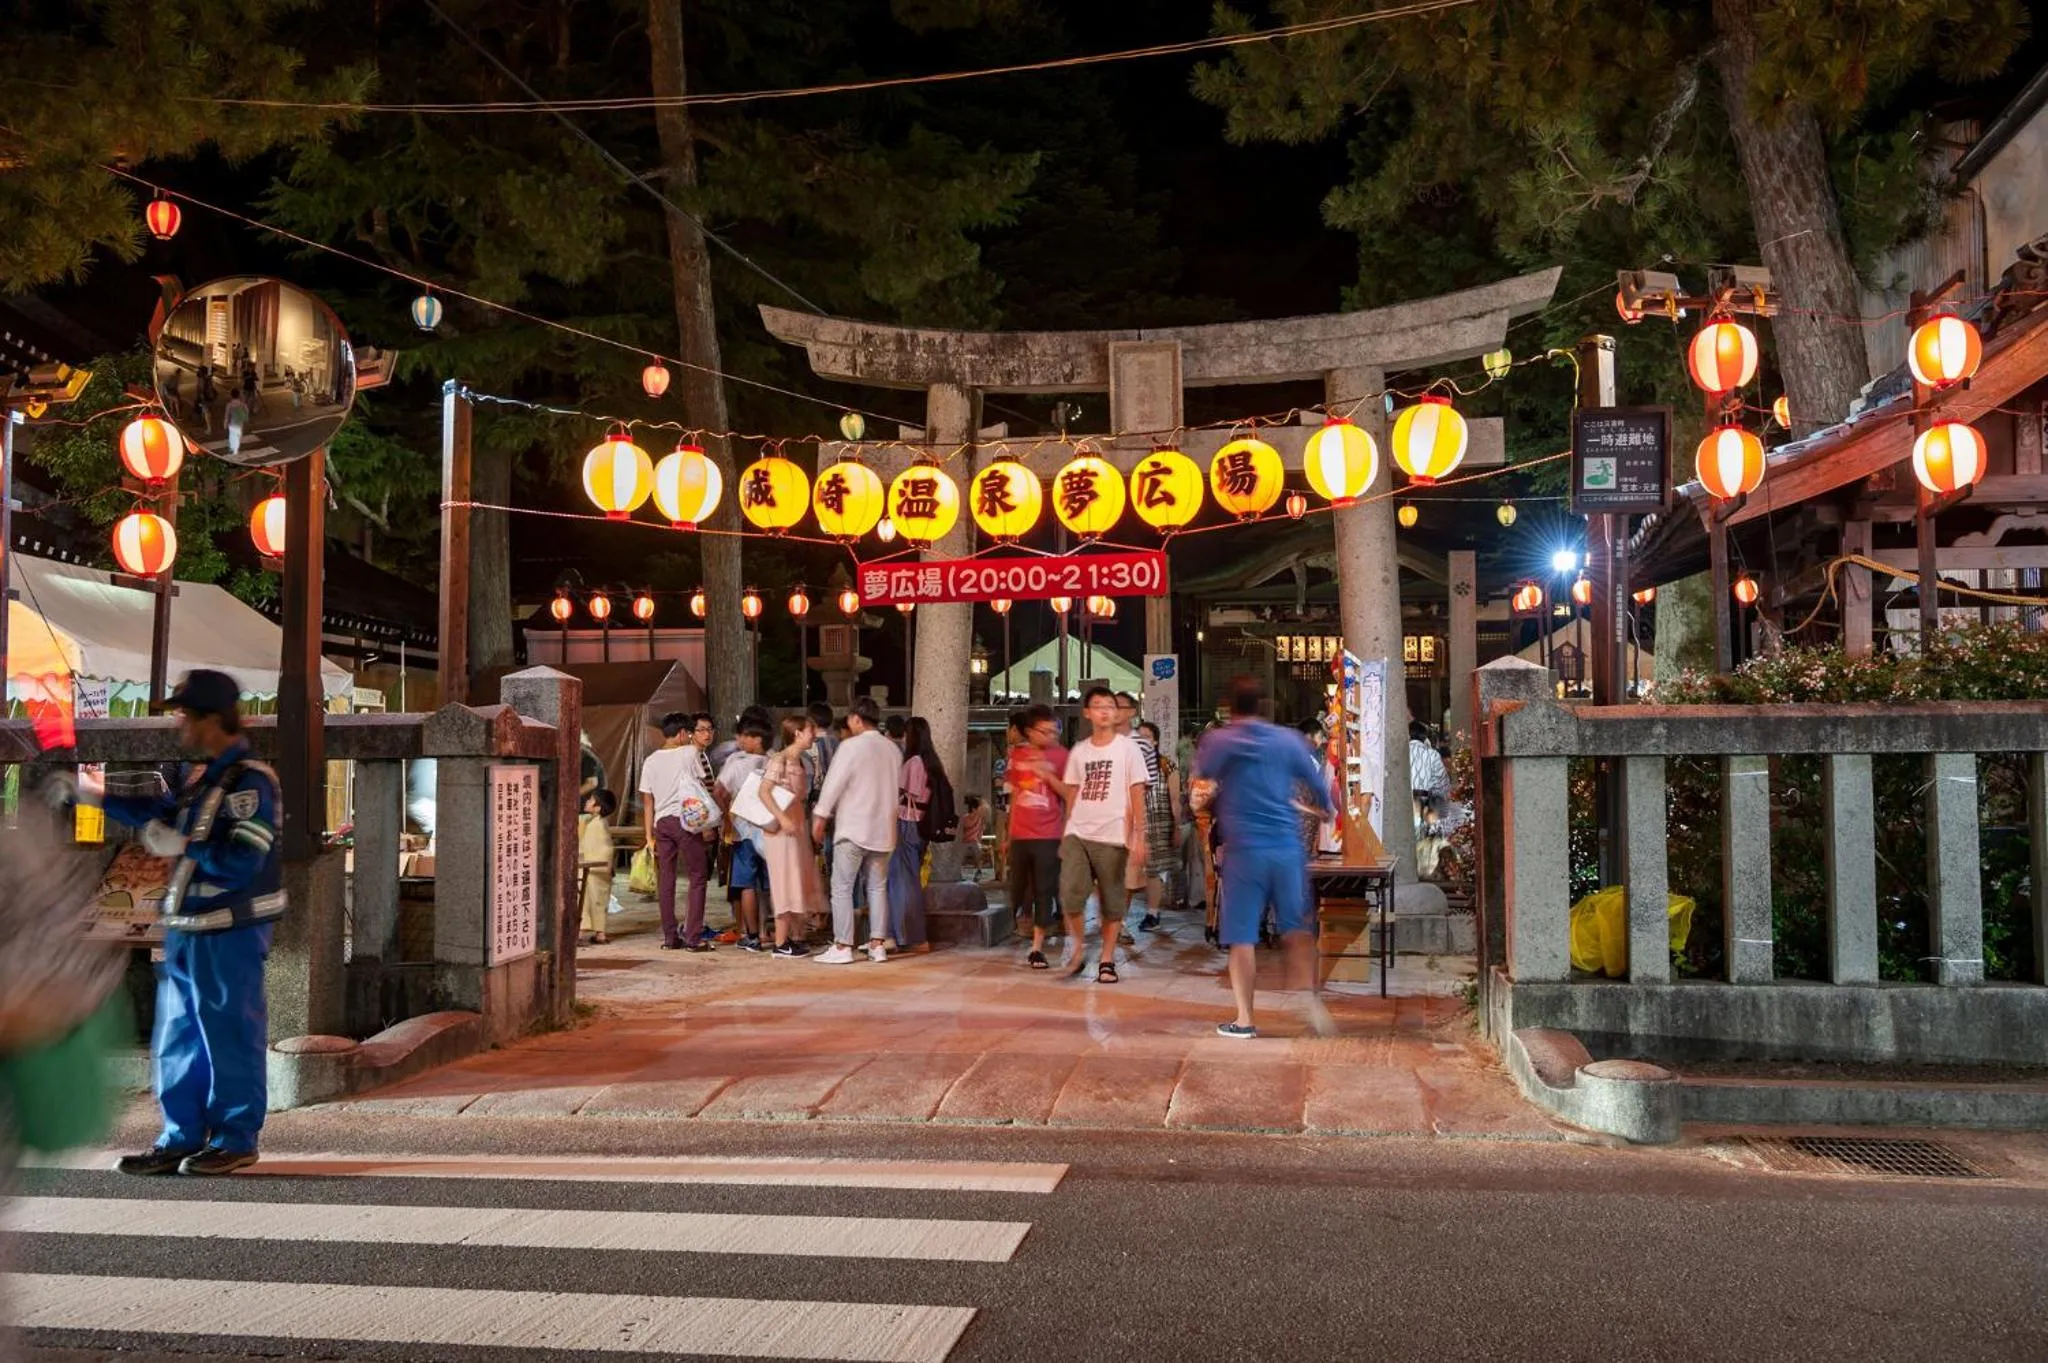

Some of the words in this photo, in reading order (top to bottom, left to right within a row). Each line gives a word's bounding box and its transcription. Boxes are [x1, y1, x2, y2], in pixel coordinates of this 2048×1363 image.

[1587, 433, 1656, 446] 一時避難地
[896, 478, 940, 519] 温
[977, 469, 1016, 518] 泉
[1060, 468, 1099, 519] 夢
[1136, 461, 1176, 508] 広
